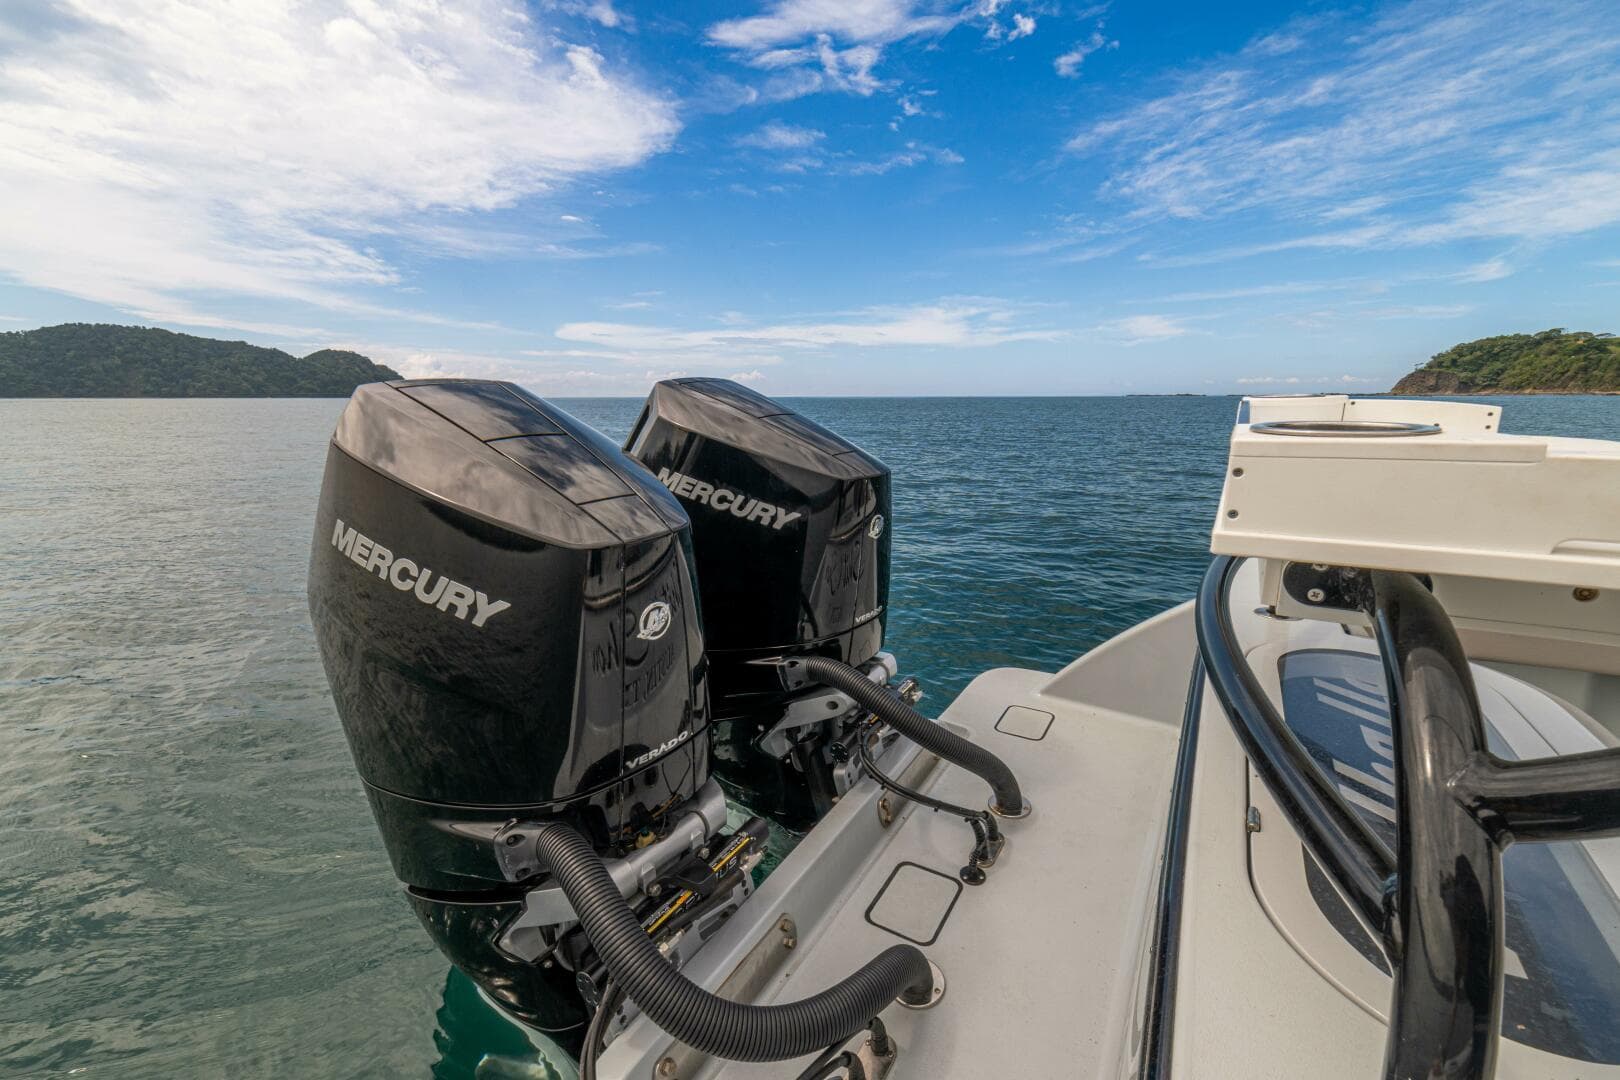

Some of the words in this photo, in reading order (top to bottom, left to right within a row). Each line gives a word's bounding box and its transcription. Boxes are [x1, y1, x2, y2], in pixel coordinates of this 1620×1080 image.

[656, 467, 801, 530] MERCURY
[331, 519, 511, 627] MERCURY
[625, 730, 689, 769] VERADO
